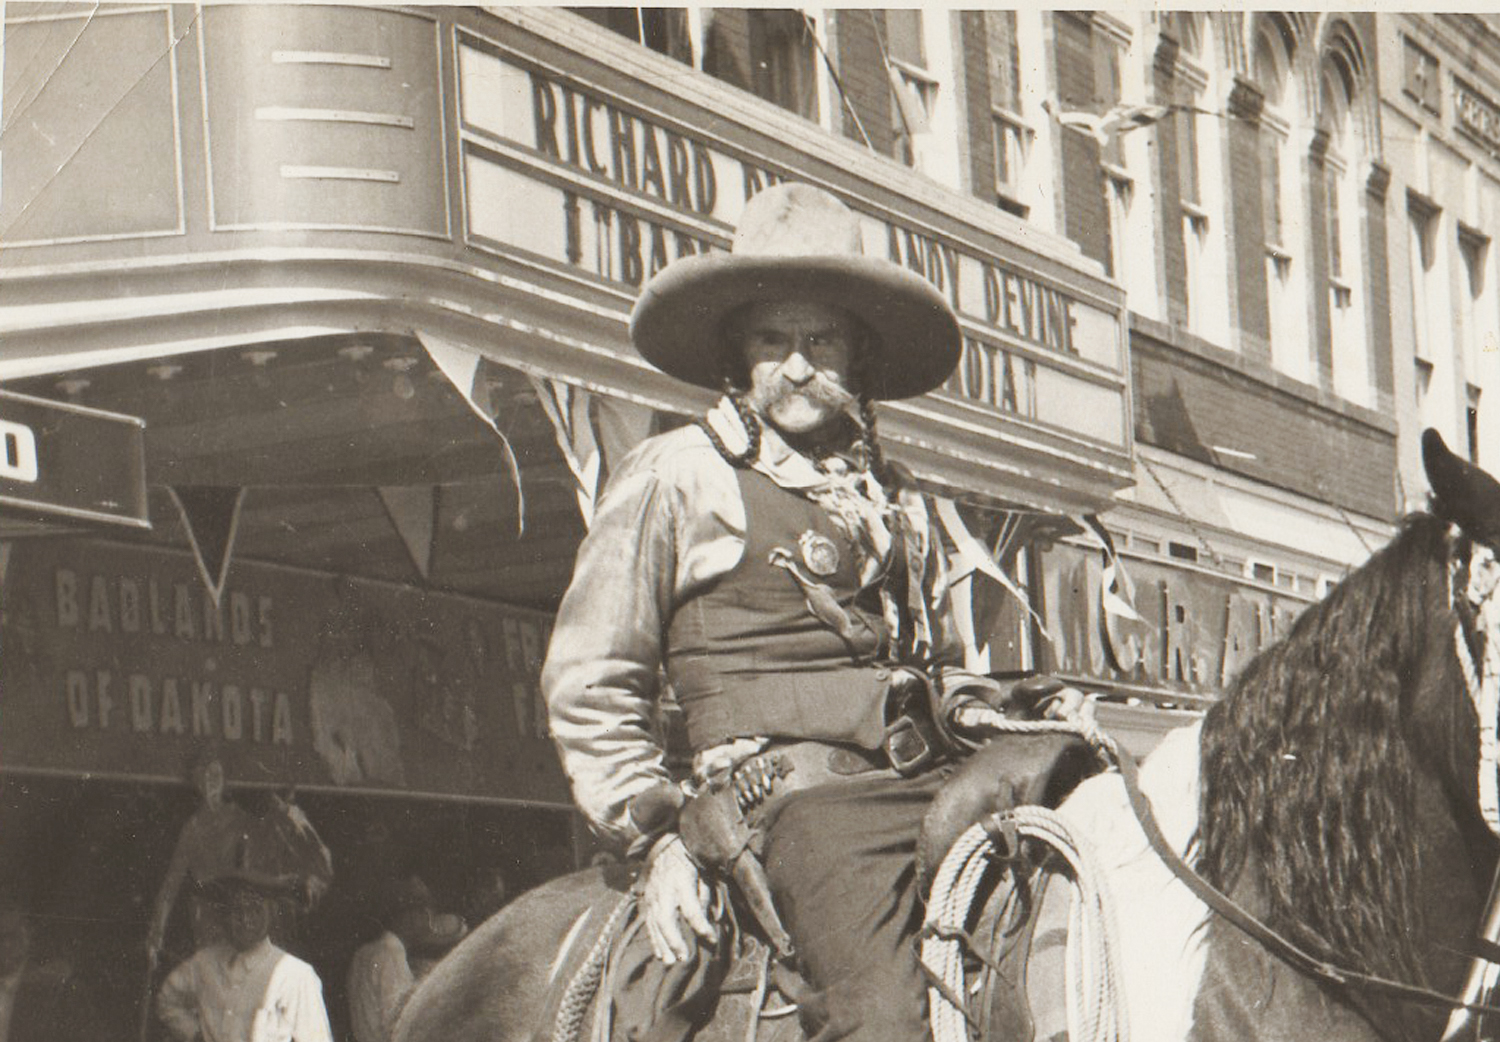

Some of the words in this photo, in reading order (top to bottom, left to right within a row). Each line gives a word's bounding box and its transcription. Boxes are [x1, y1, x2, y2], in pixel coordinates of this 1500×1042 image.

[533, 72, 717, 216] RICHARD
[982, 262, 1080, 358] DEVINE
[56, 569, 273, 648] BADLANDS
[67, 669, 112, 729] OF
[129, 674, 293, 745] DAKOTA
